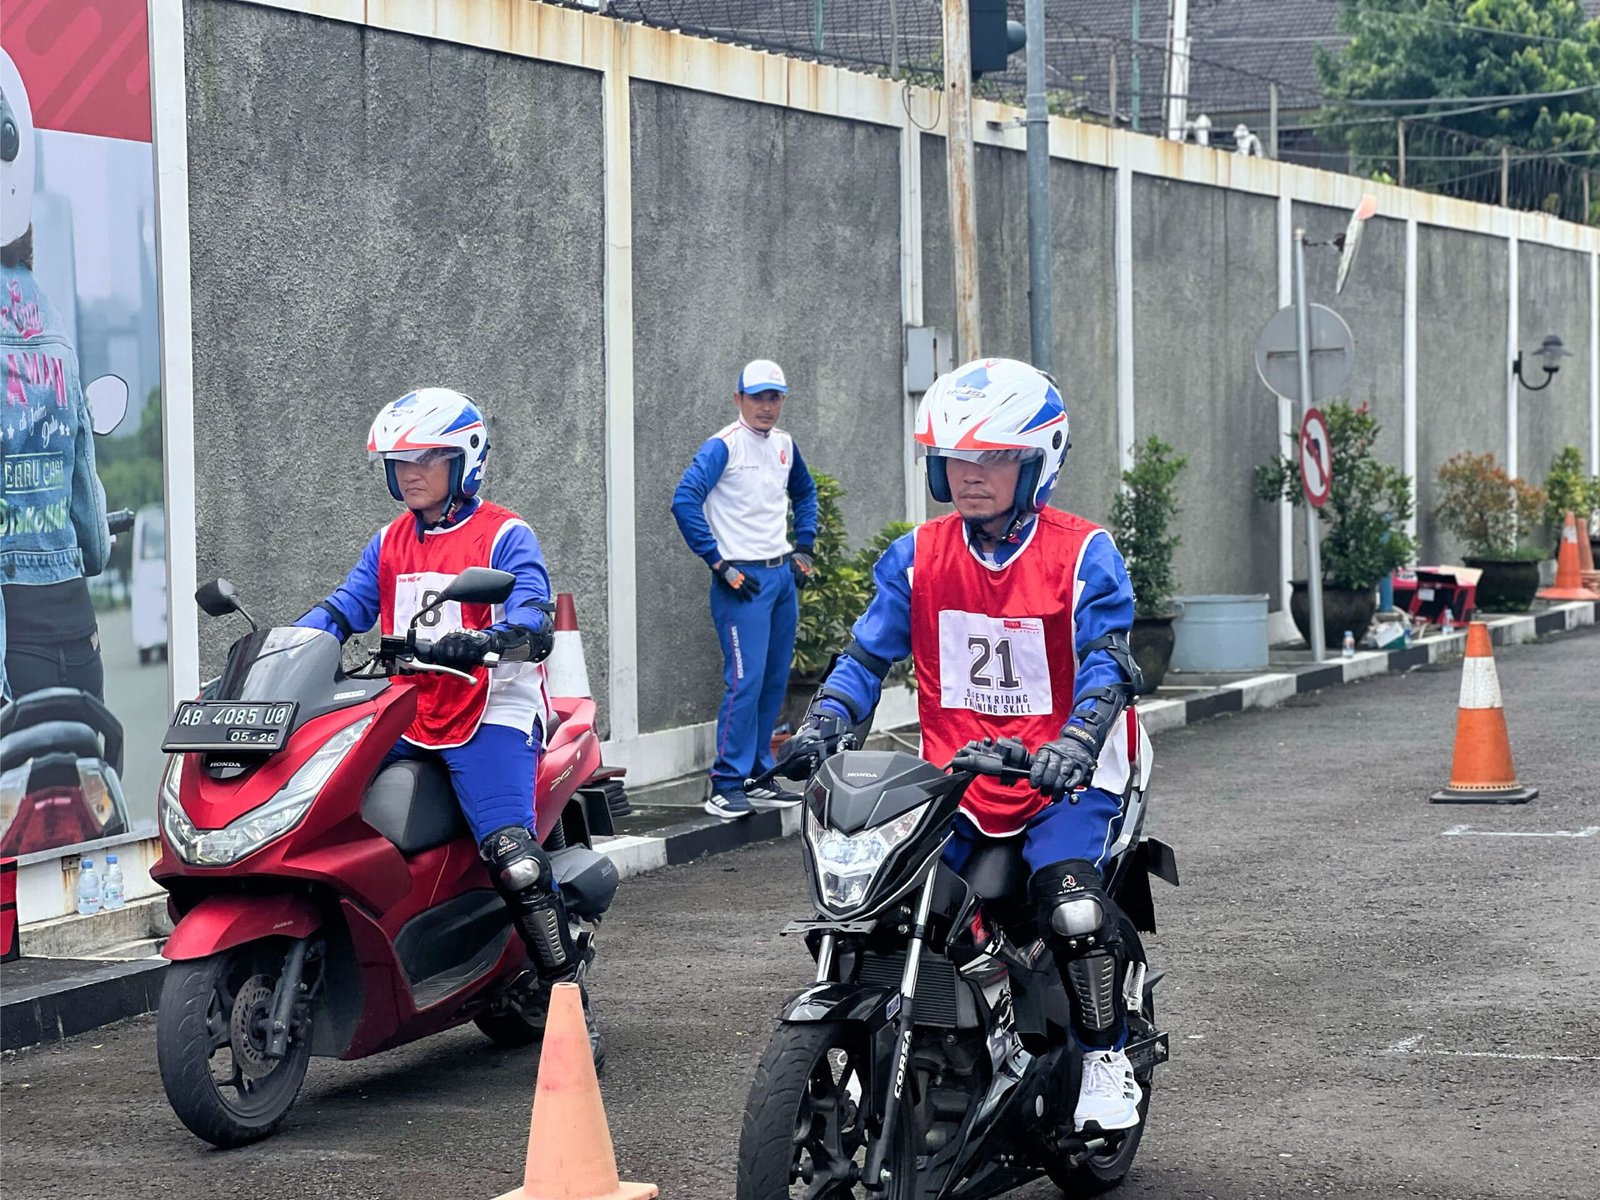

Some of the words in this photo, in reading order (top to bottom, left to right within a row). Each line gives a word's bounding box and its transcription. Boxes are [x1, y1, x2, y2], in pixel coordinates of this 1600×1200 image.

[419, 590, 445, 628] 8
[967, 635, 1021, 690] 21
[966, 688, 992, 703] SETY
[994, 694, 1028, 705] RIDING
[180, 708, 203, 726] AB
[211, 707, 259, 726] 4085
[1003, 703, 1032, 714] SKILL
[846, 771, 878, 779] HONDA
[894, 1030, 913, 1099] CORSA
